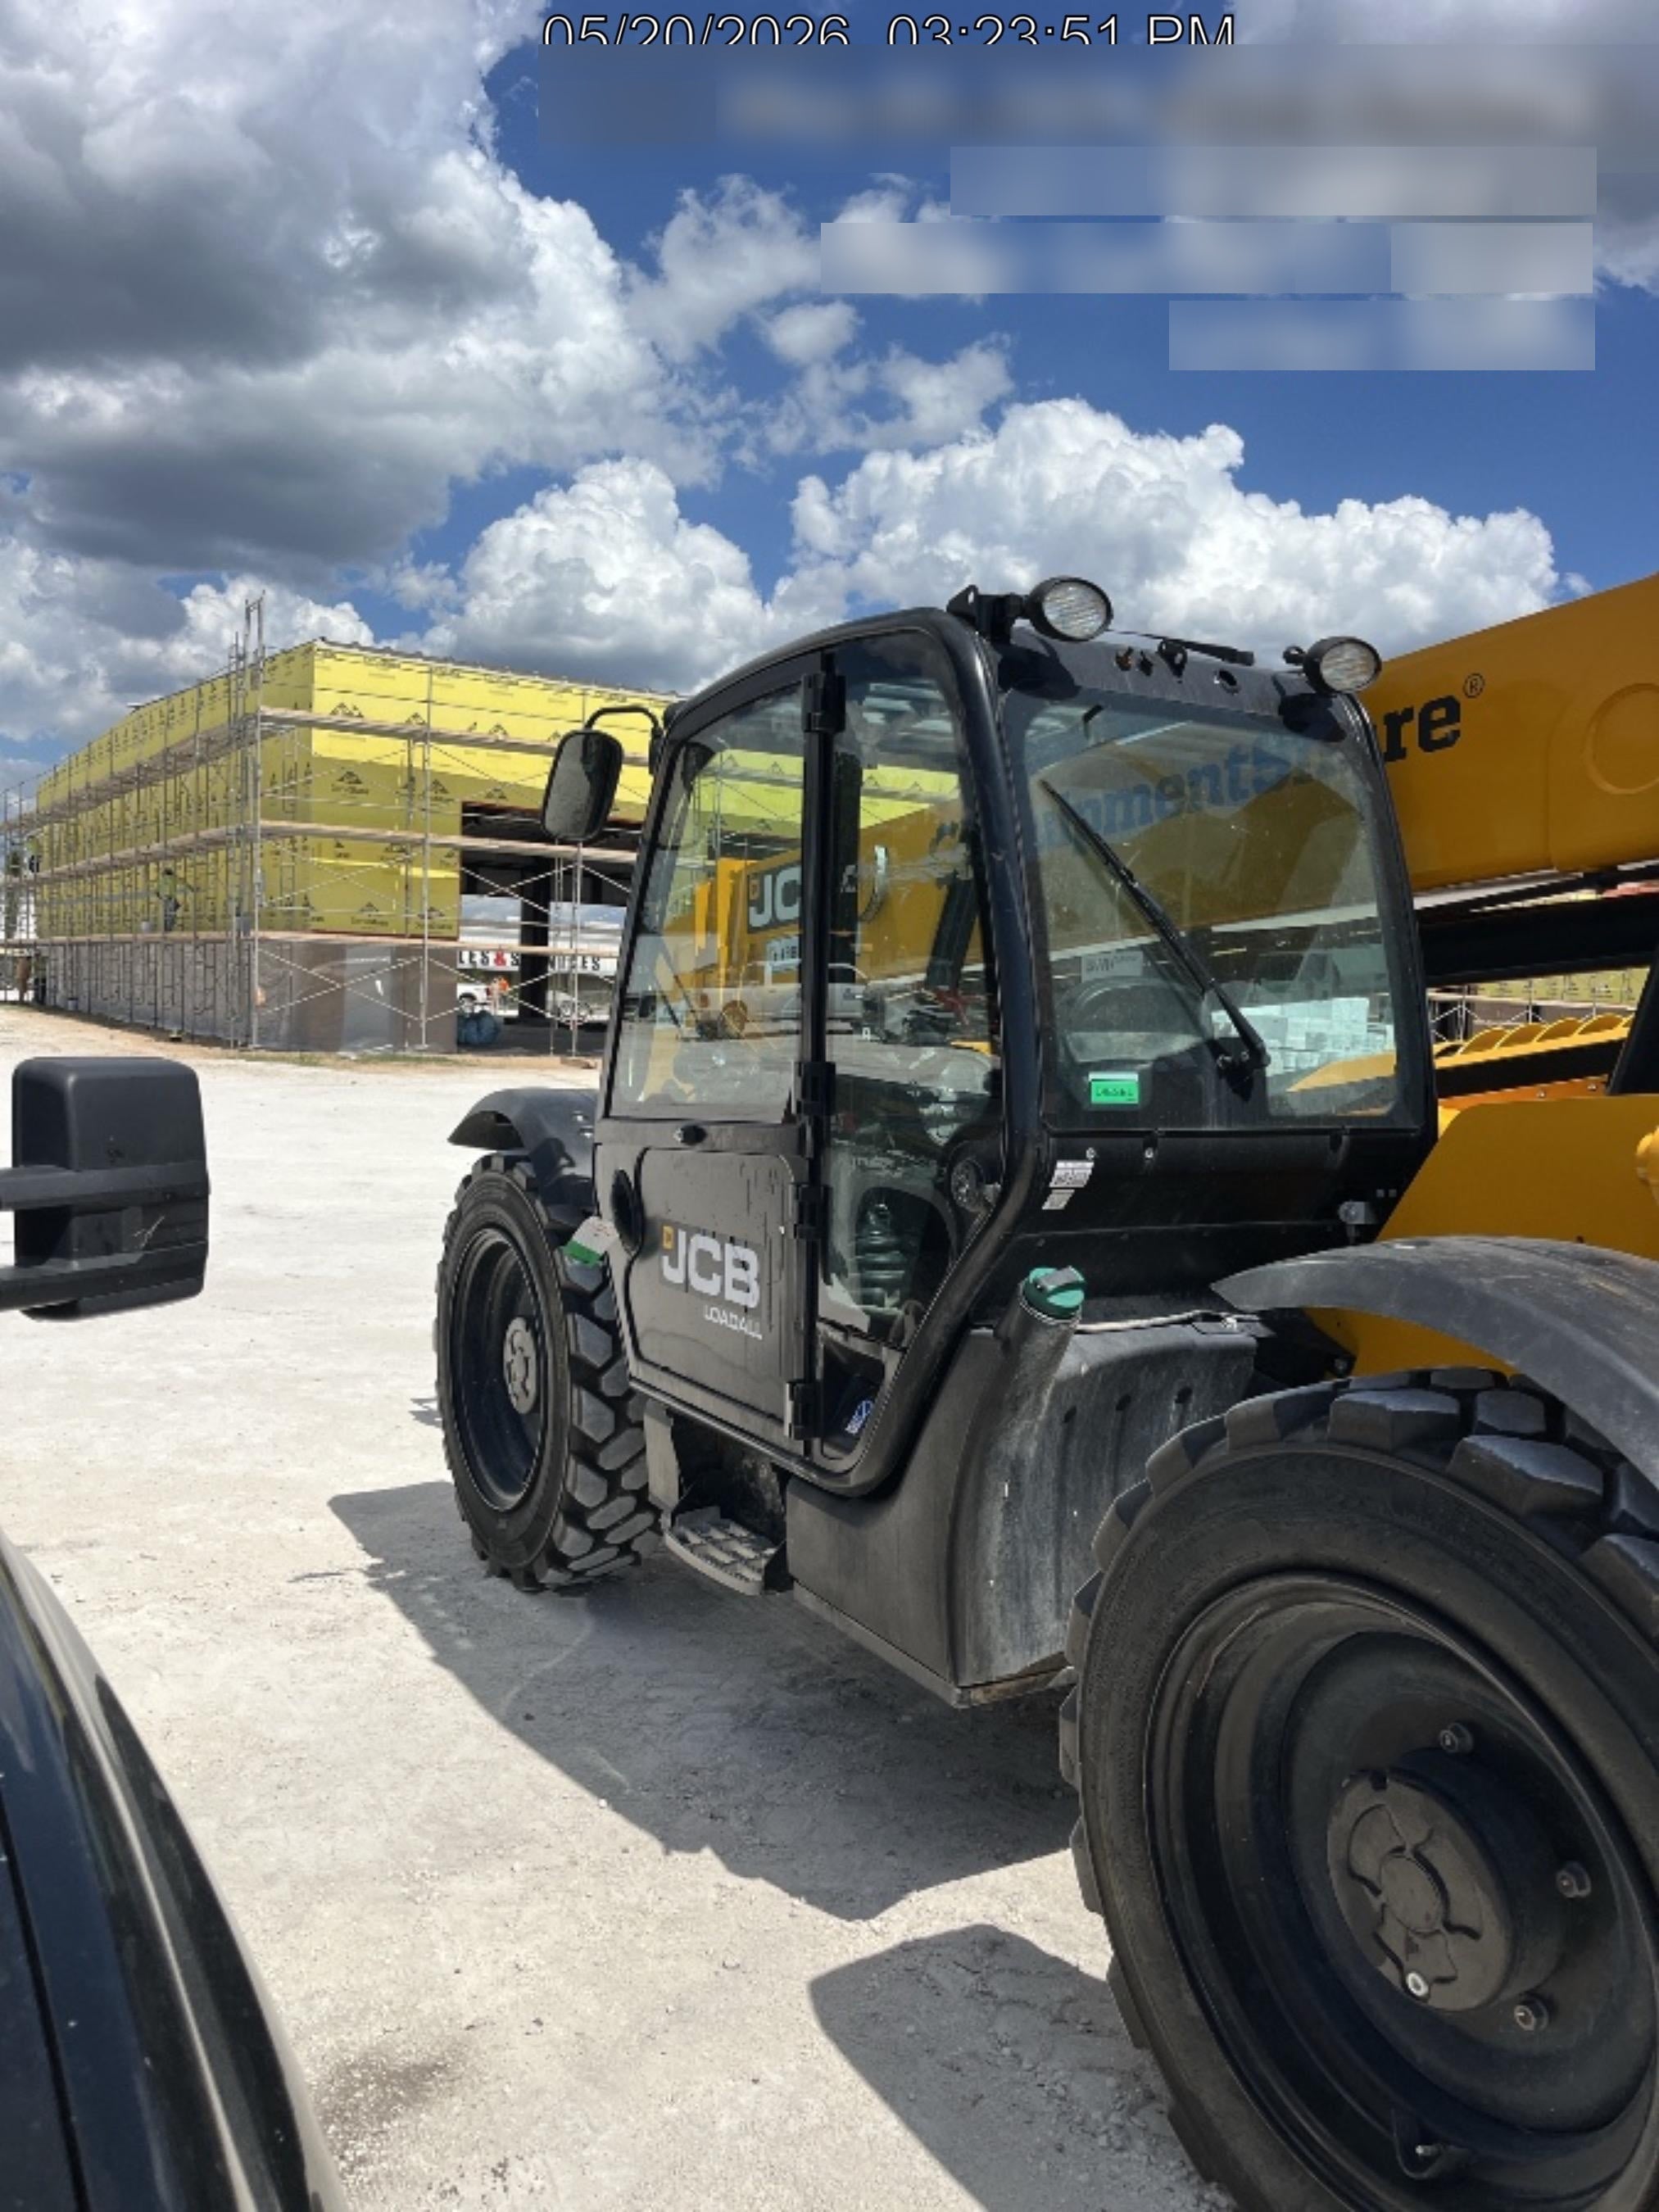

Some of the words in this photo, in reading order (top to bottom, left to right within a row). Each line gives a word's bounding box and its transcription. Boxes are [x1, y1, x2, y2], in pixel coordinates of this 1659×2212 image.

[749, 865, 801, 927] JC
[458, 950, 489, 966] LES
[493, 950, 506, 966] &
[662, 1229, 760, 1308] JCB
[704, 1304, 763, 1339] LOADALL
